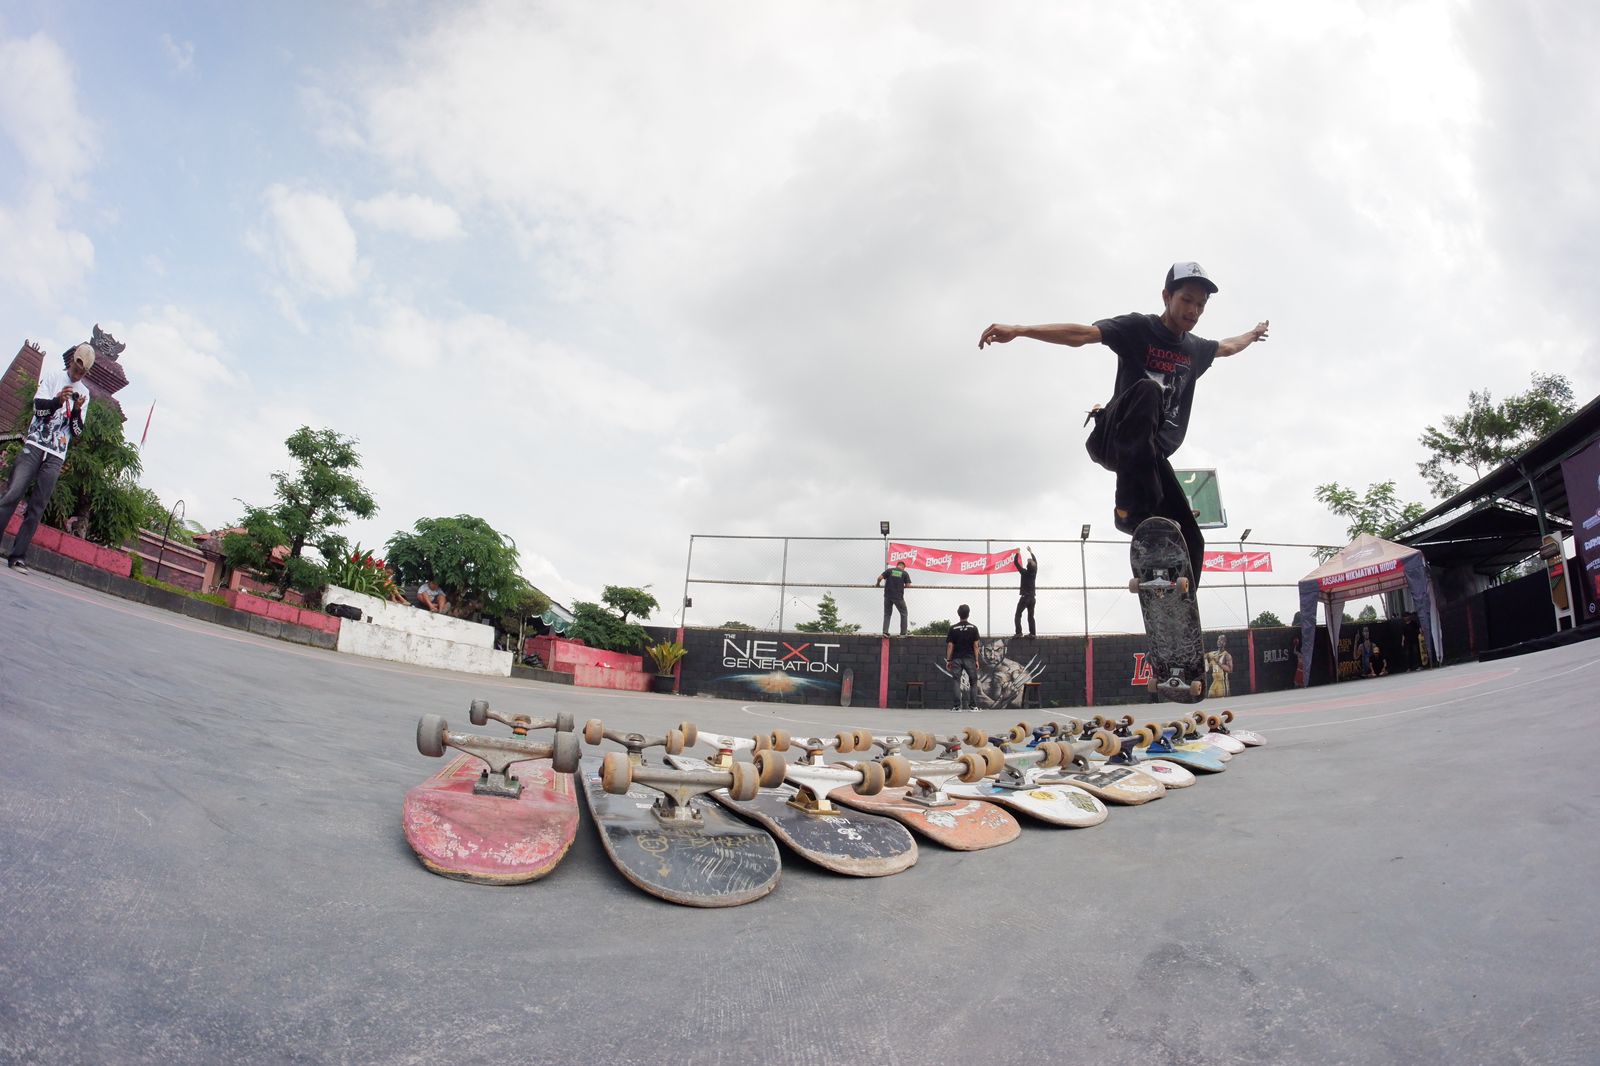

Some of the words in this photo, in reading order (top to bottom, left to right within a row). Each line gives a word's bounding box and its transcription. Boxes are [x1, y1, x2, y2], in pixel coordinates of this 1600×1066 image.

[723, 638, 841, 663] NEXT
[1263, 649, 1289, 663] BULLS
[722, 657, 839, 673] GENERATION
